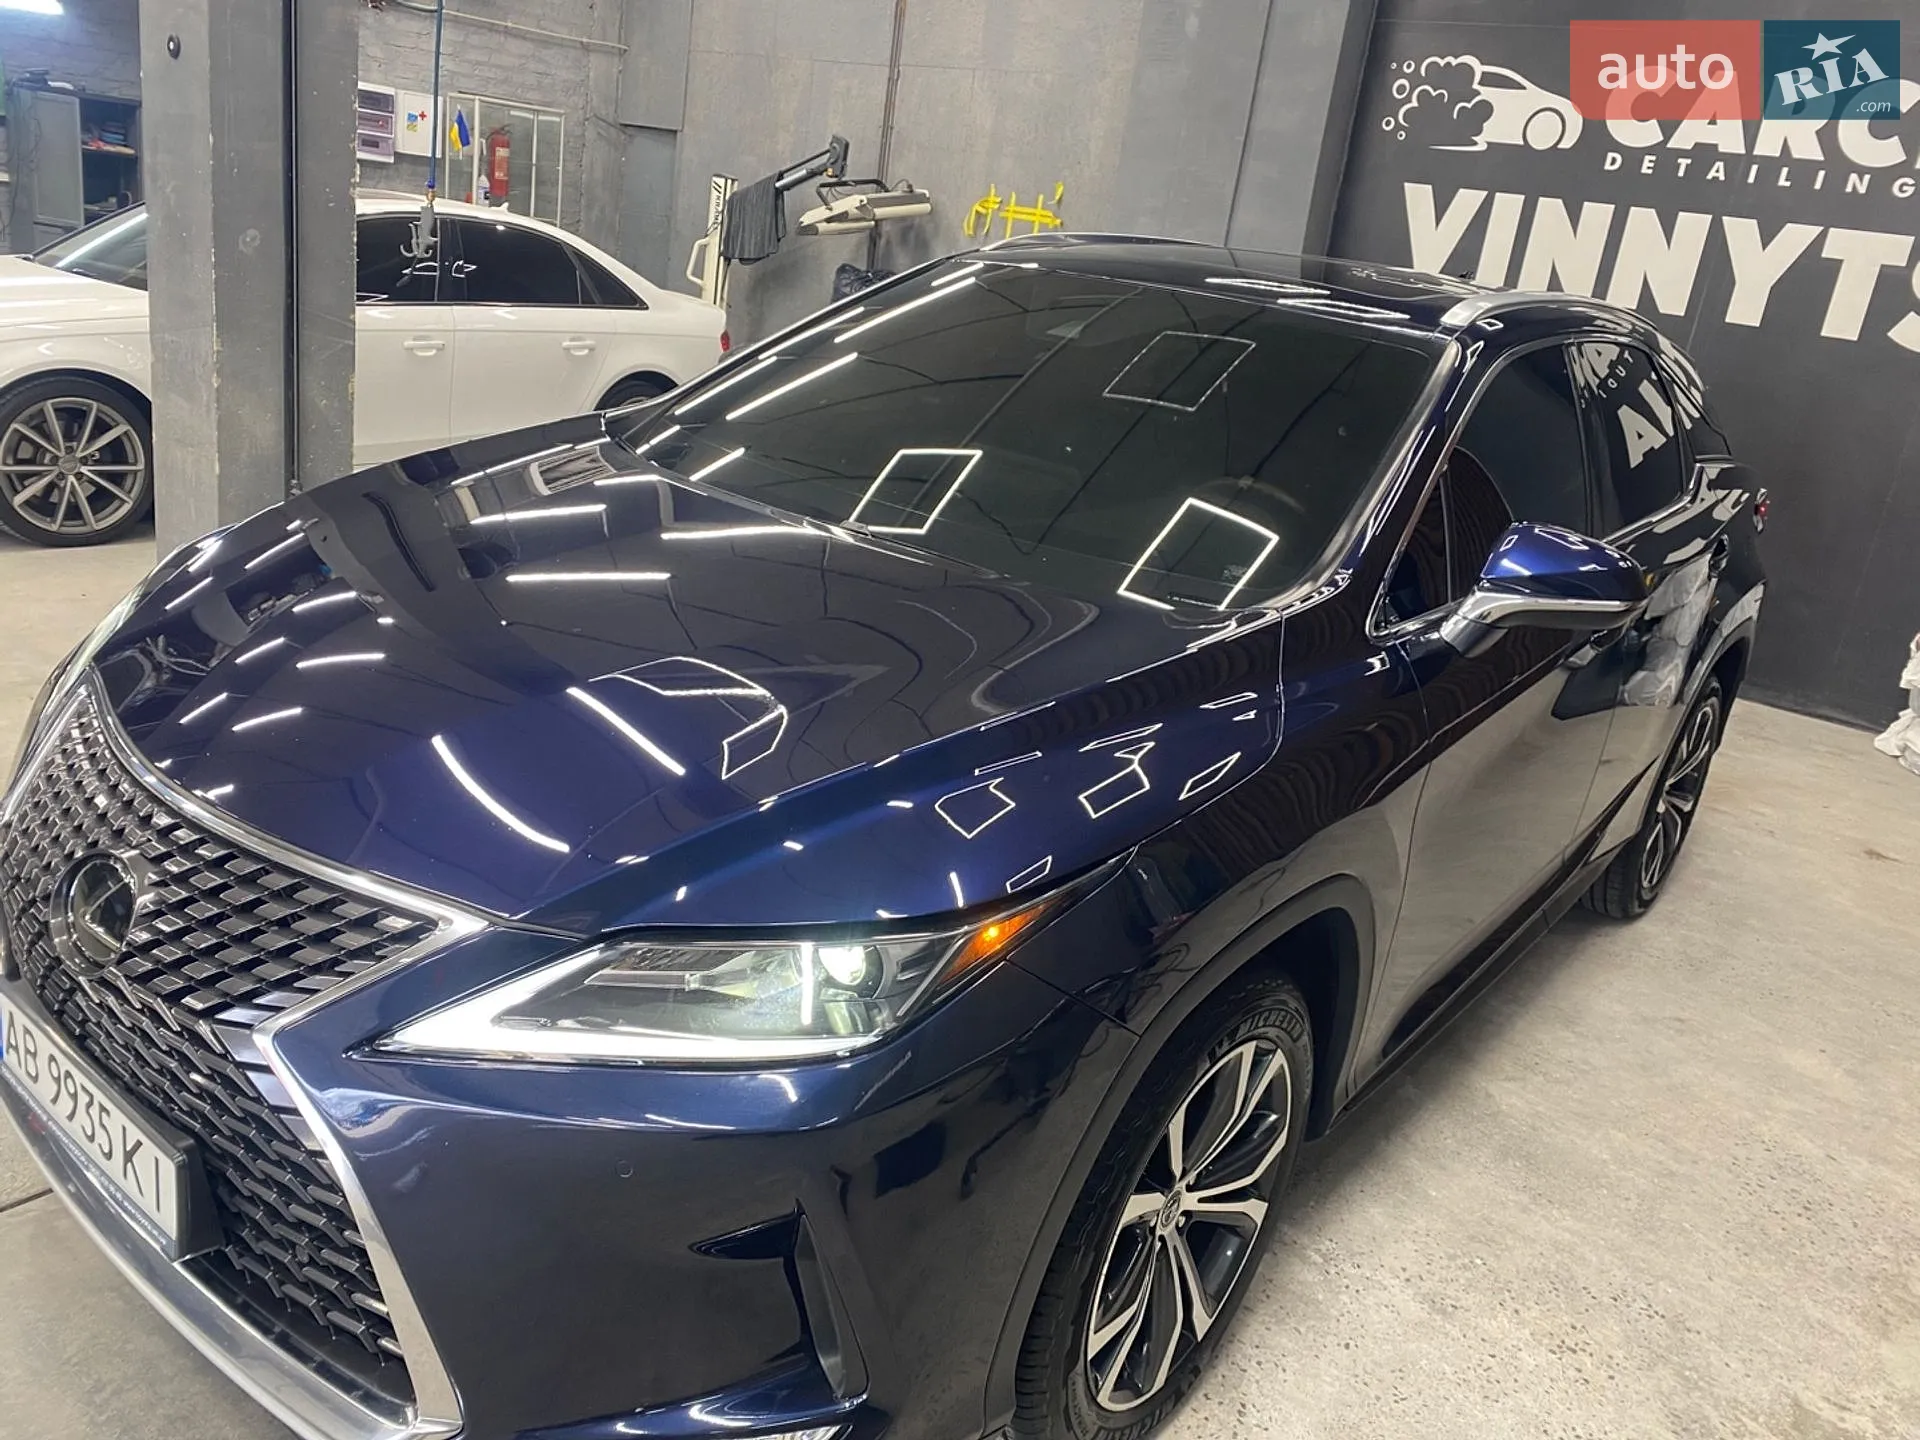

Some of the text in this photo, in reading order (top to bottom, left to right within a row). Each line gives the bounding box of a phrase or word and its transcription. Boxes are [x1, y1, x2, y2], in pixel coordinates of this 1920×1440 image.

[1604, 65, 1920, 170] CARC
[1603, 152, 1917, 198] DETAILING
[1235, 1009, 1303, 1041] MICHELIN
[5, 1011, 39, 1085] AB
[47, 1053, 113, 1162] 9935
